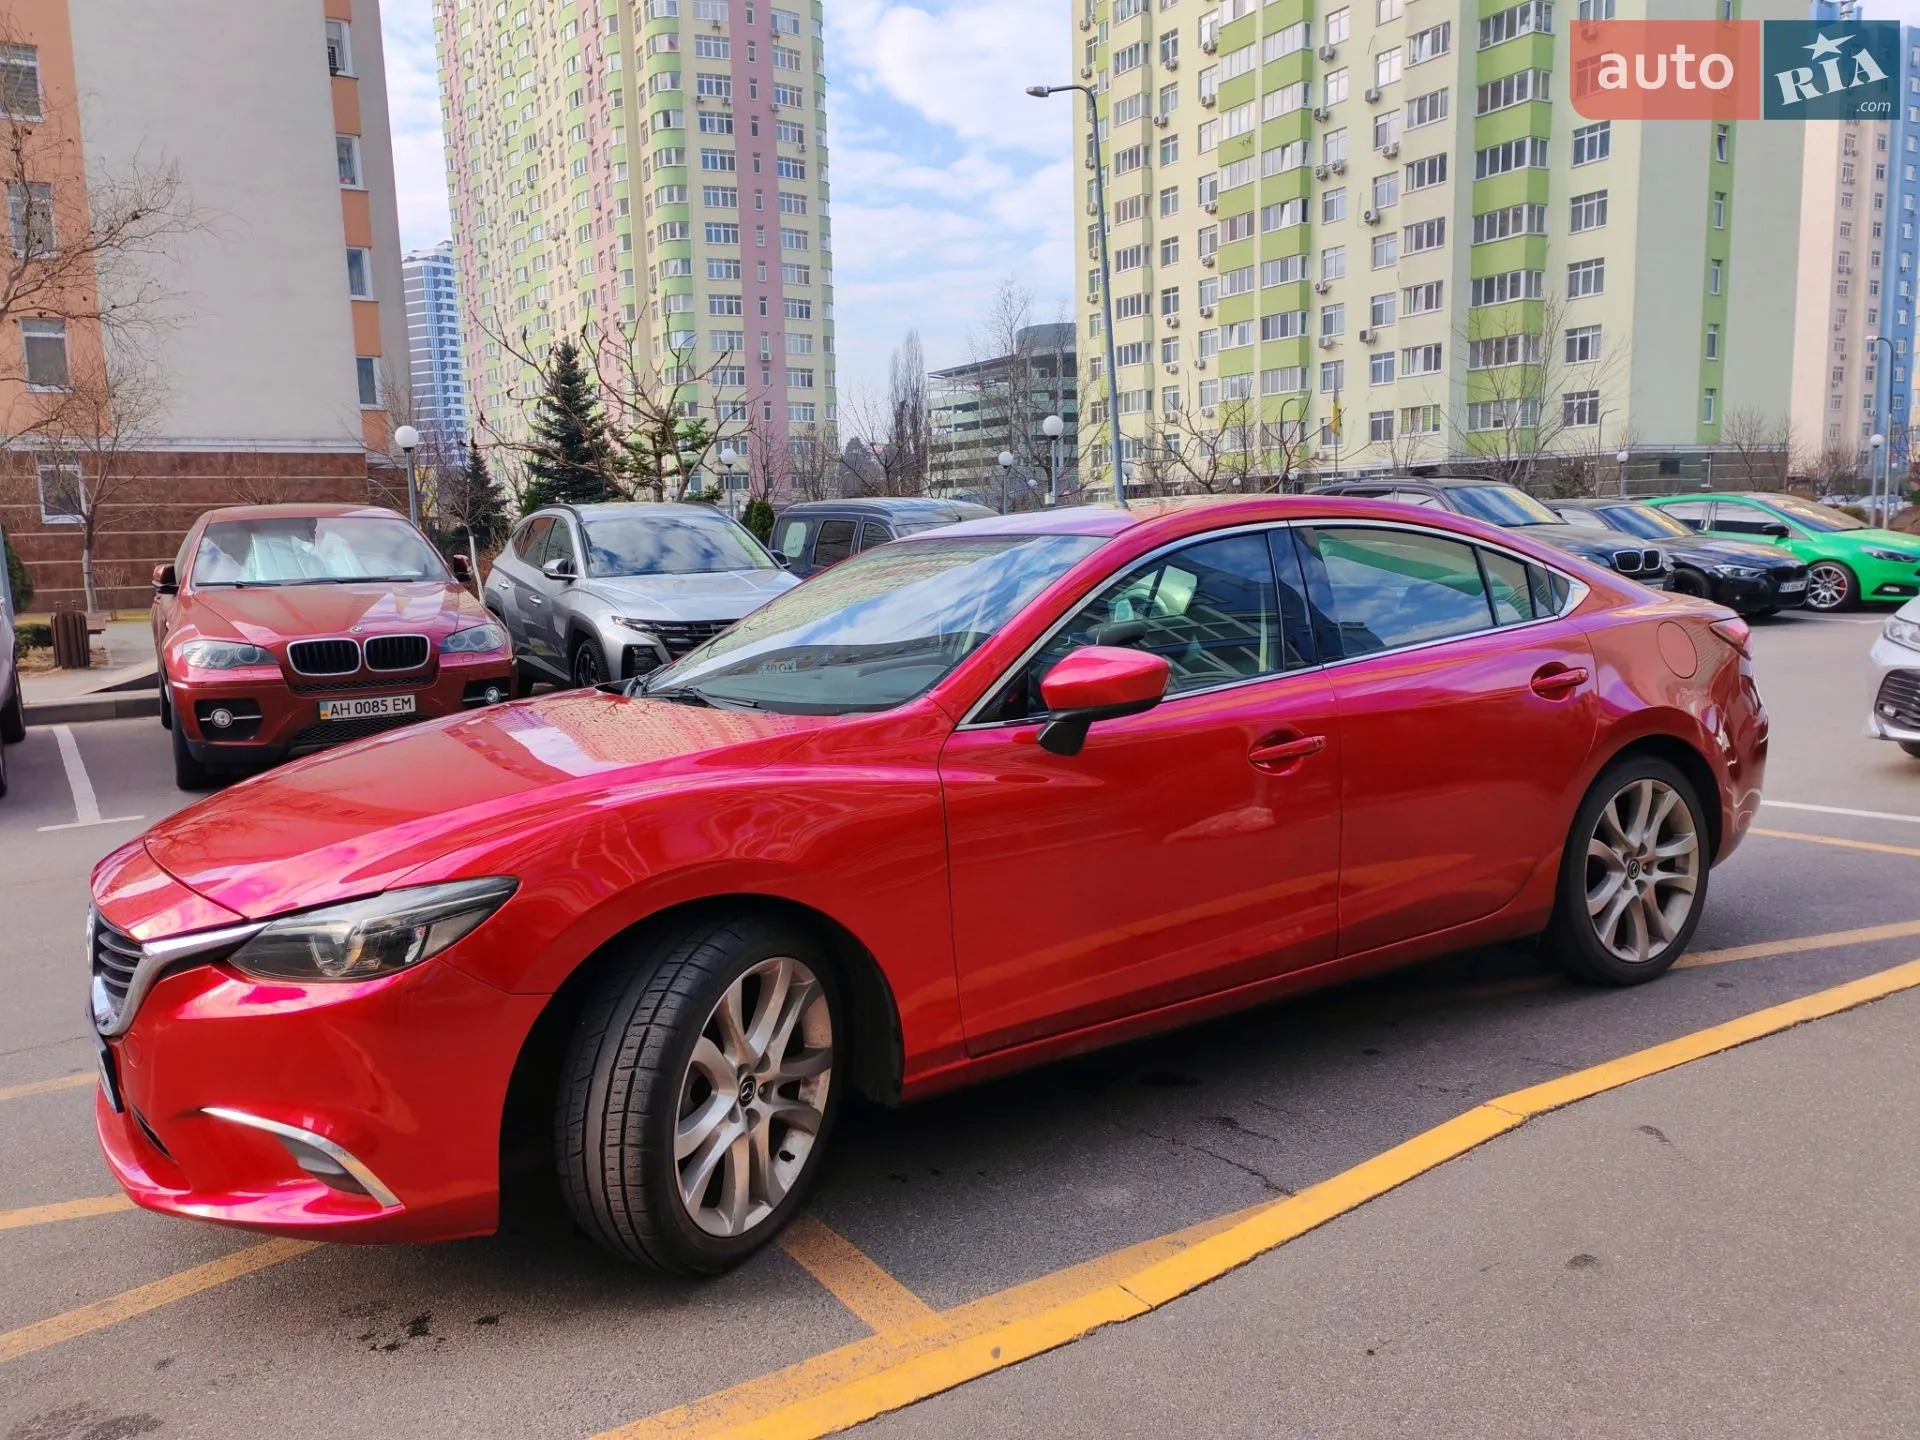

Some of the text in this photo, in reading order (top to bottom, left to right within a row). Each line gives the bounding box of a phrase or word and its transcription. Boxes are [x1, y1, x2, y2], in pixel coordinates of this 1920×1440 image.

[330, 697, 412, 717] AH 0085 EM
